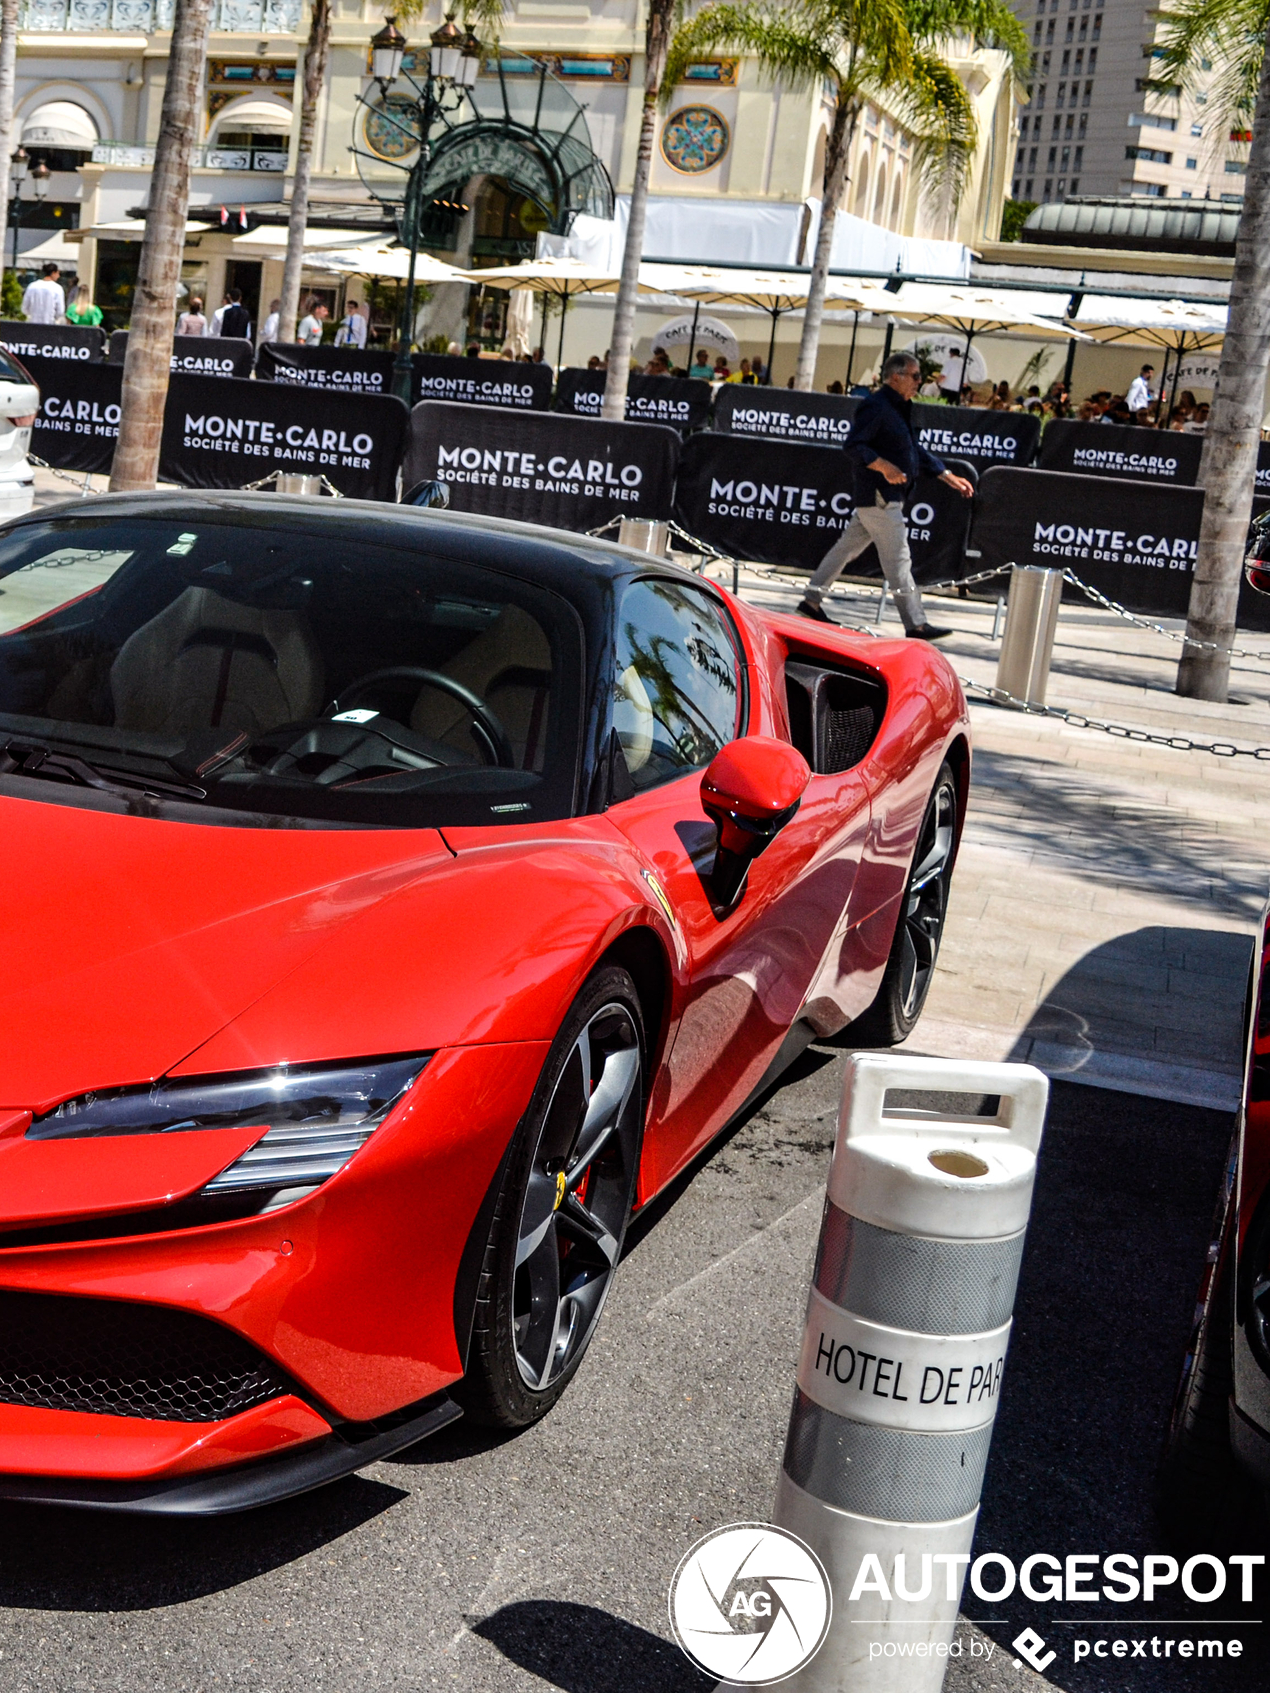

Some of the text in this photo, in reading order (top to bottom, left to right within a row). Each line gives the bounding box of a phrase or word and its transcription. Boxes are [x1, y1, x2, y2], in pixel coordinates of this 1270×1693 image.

[34, 418, 120, 438] BAINS DE MER
[769, 425, 786, 435] DES
[788, 427, 814, 438] BAINS
[816, 430, 828, 439] DE
[183, 435, 371, 470] SOCIÉTÉ DES BAINS DE MER
[930, 443, 948, 452] DES
[950, 445, 978, 456] BAINS
[980, 448, 994, 457] DE
[995, 450, 1015, 459] MER
[436, 468, 640, 502] SOCIÉTÉ DES BAINS DE MER
[708, 502, 931, 542] SOCIÉTÉ DES BAIN ER
[1033, 542, 1089, 558] SOCIÉTÉ
[1093, 549, 1119, 562] DES
[1123, 553, 1165, 568] BAINS
[1169, 559, 1187, 571] DE
[815, 1333, 908, 1402] HOTEL
[919, 1366, 963, 1405] DE
